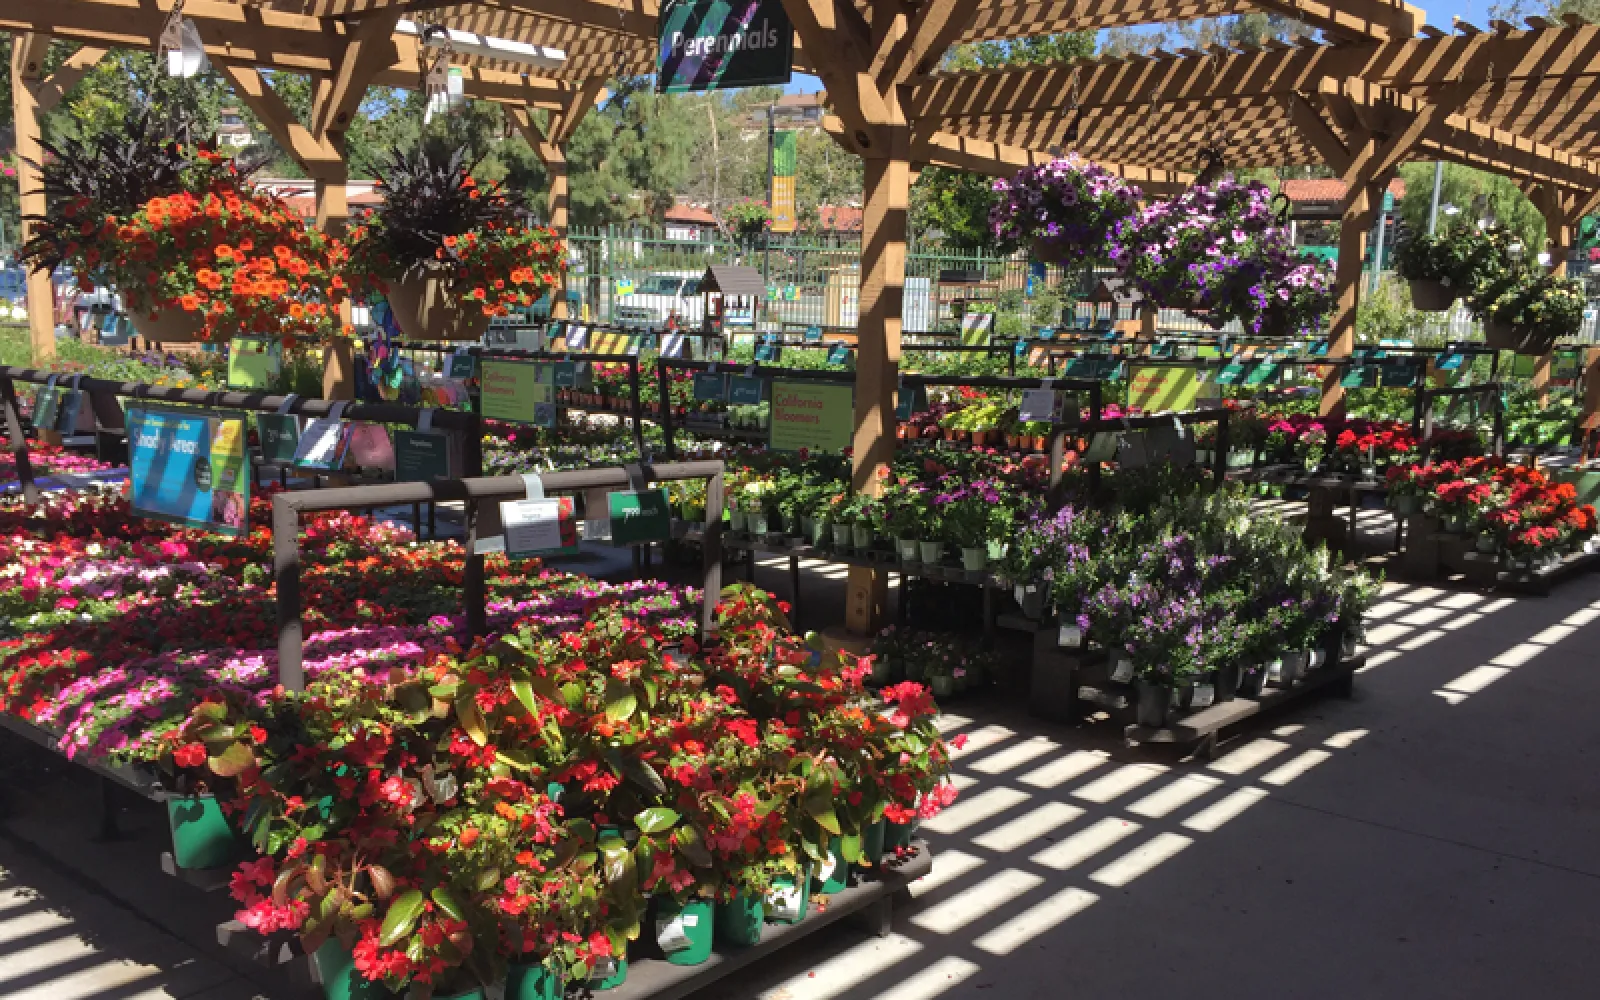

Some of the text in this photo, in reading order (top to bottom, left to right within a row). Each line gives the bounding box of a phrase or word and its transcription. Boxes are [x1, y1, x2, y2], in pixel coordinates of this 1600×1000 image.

[671, 18, 778, 57] Perennials
[775, 393, 823, 410] California
[775, 408, 820, 424] Bloomers
